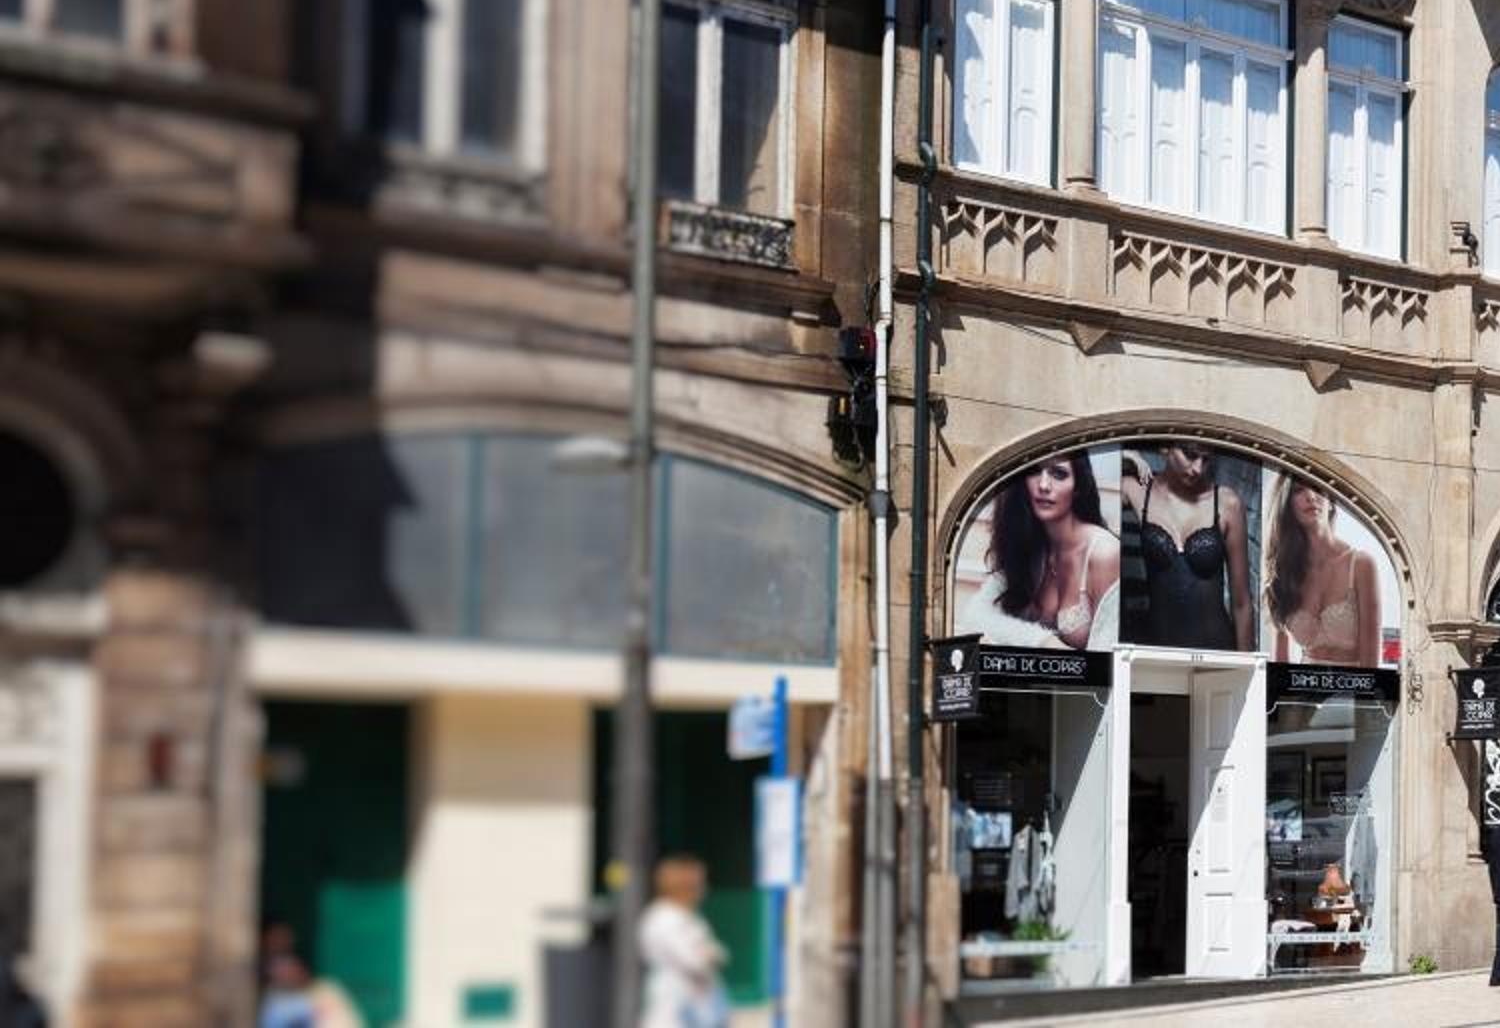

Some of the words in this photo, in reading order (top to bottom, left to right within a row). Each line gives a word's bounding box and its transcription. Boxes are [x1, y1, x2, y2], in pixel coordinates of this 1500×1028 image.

[983, 656, 1017, 671] DAMA
[1021, 658, 1035, 672] DE
[1039, 659, 1083, 675] COPAS
[1291, 673, 1319, 687] DAMA
[1321, 675, 1333, 688] DE
